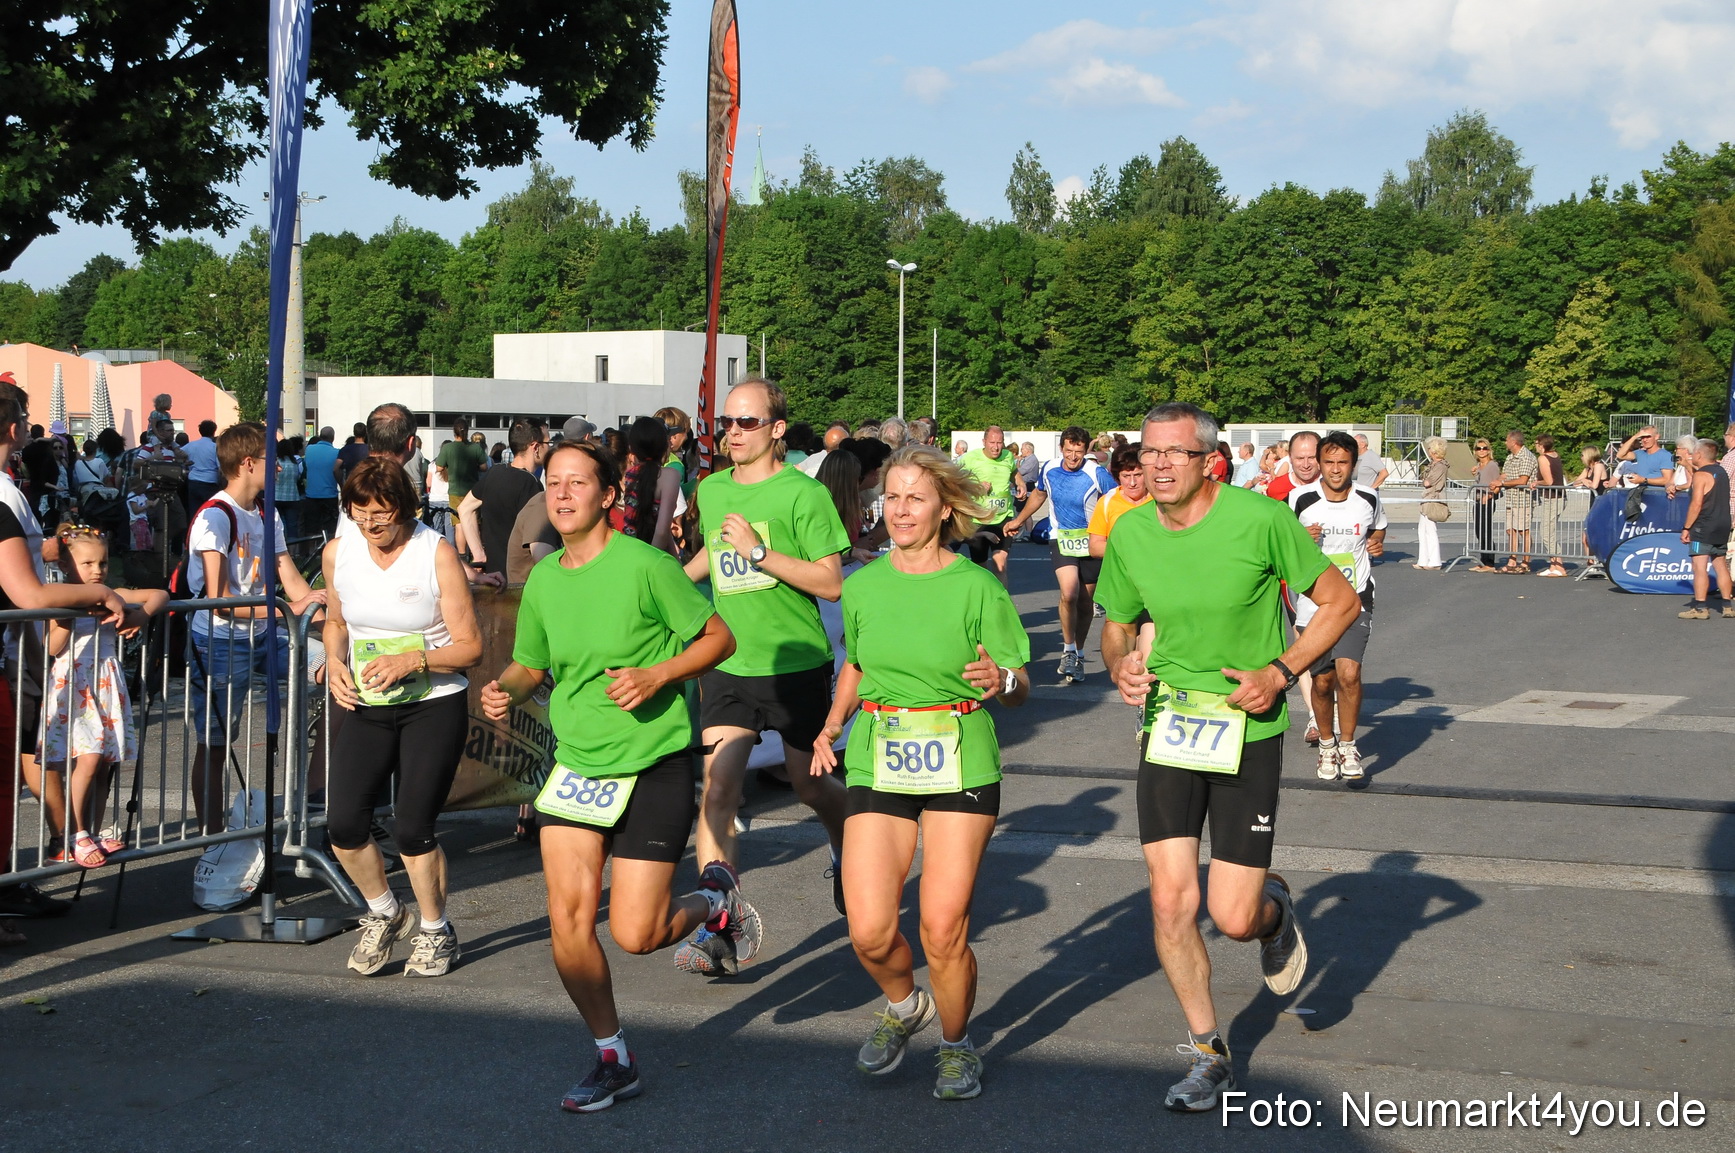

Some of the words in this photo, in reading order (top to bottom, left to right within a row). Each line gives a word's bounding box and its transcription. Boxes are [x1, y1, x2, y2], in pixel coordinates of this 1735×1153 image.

[1619, 521, 1672, 540] Fisch
[1059, 537, 1089, 550] 1039
[720, 552, 762, 577] 60
[1638, 559, 1713, 573] Fischr
[1164, 713, 1230, 751] 577
[886, 740, 945, 774] 580
[556, 771, 619, 809] 588
[1250, 824, 1272, 832] erima
